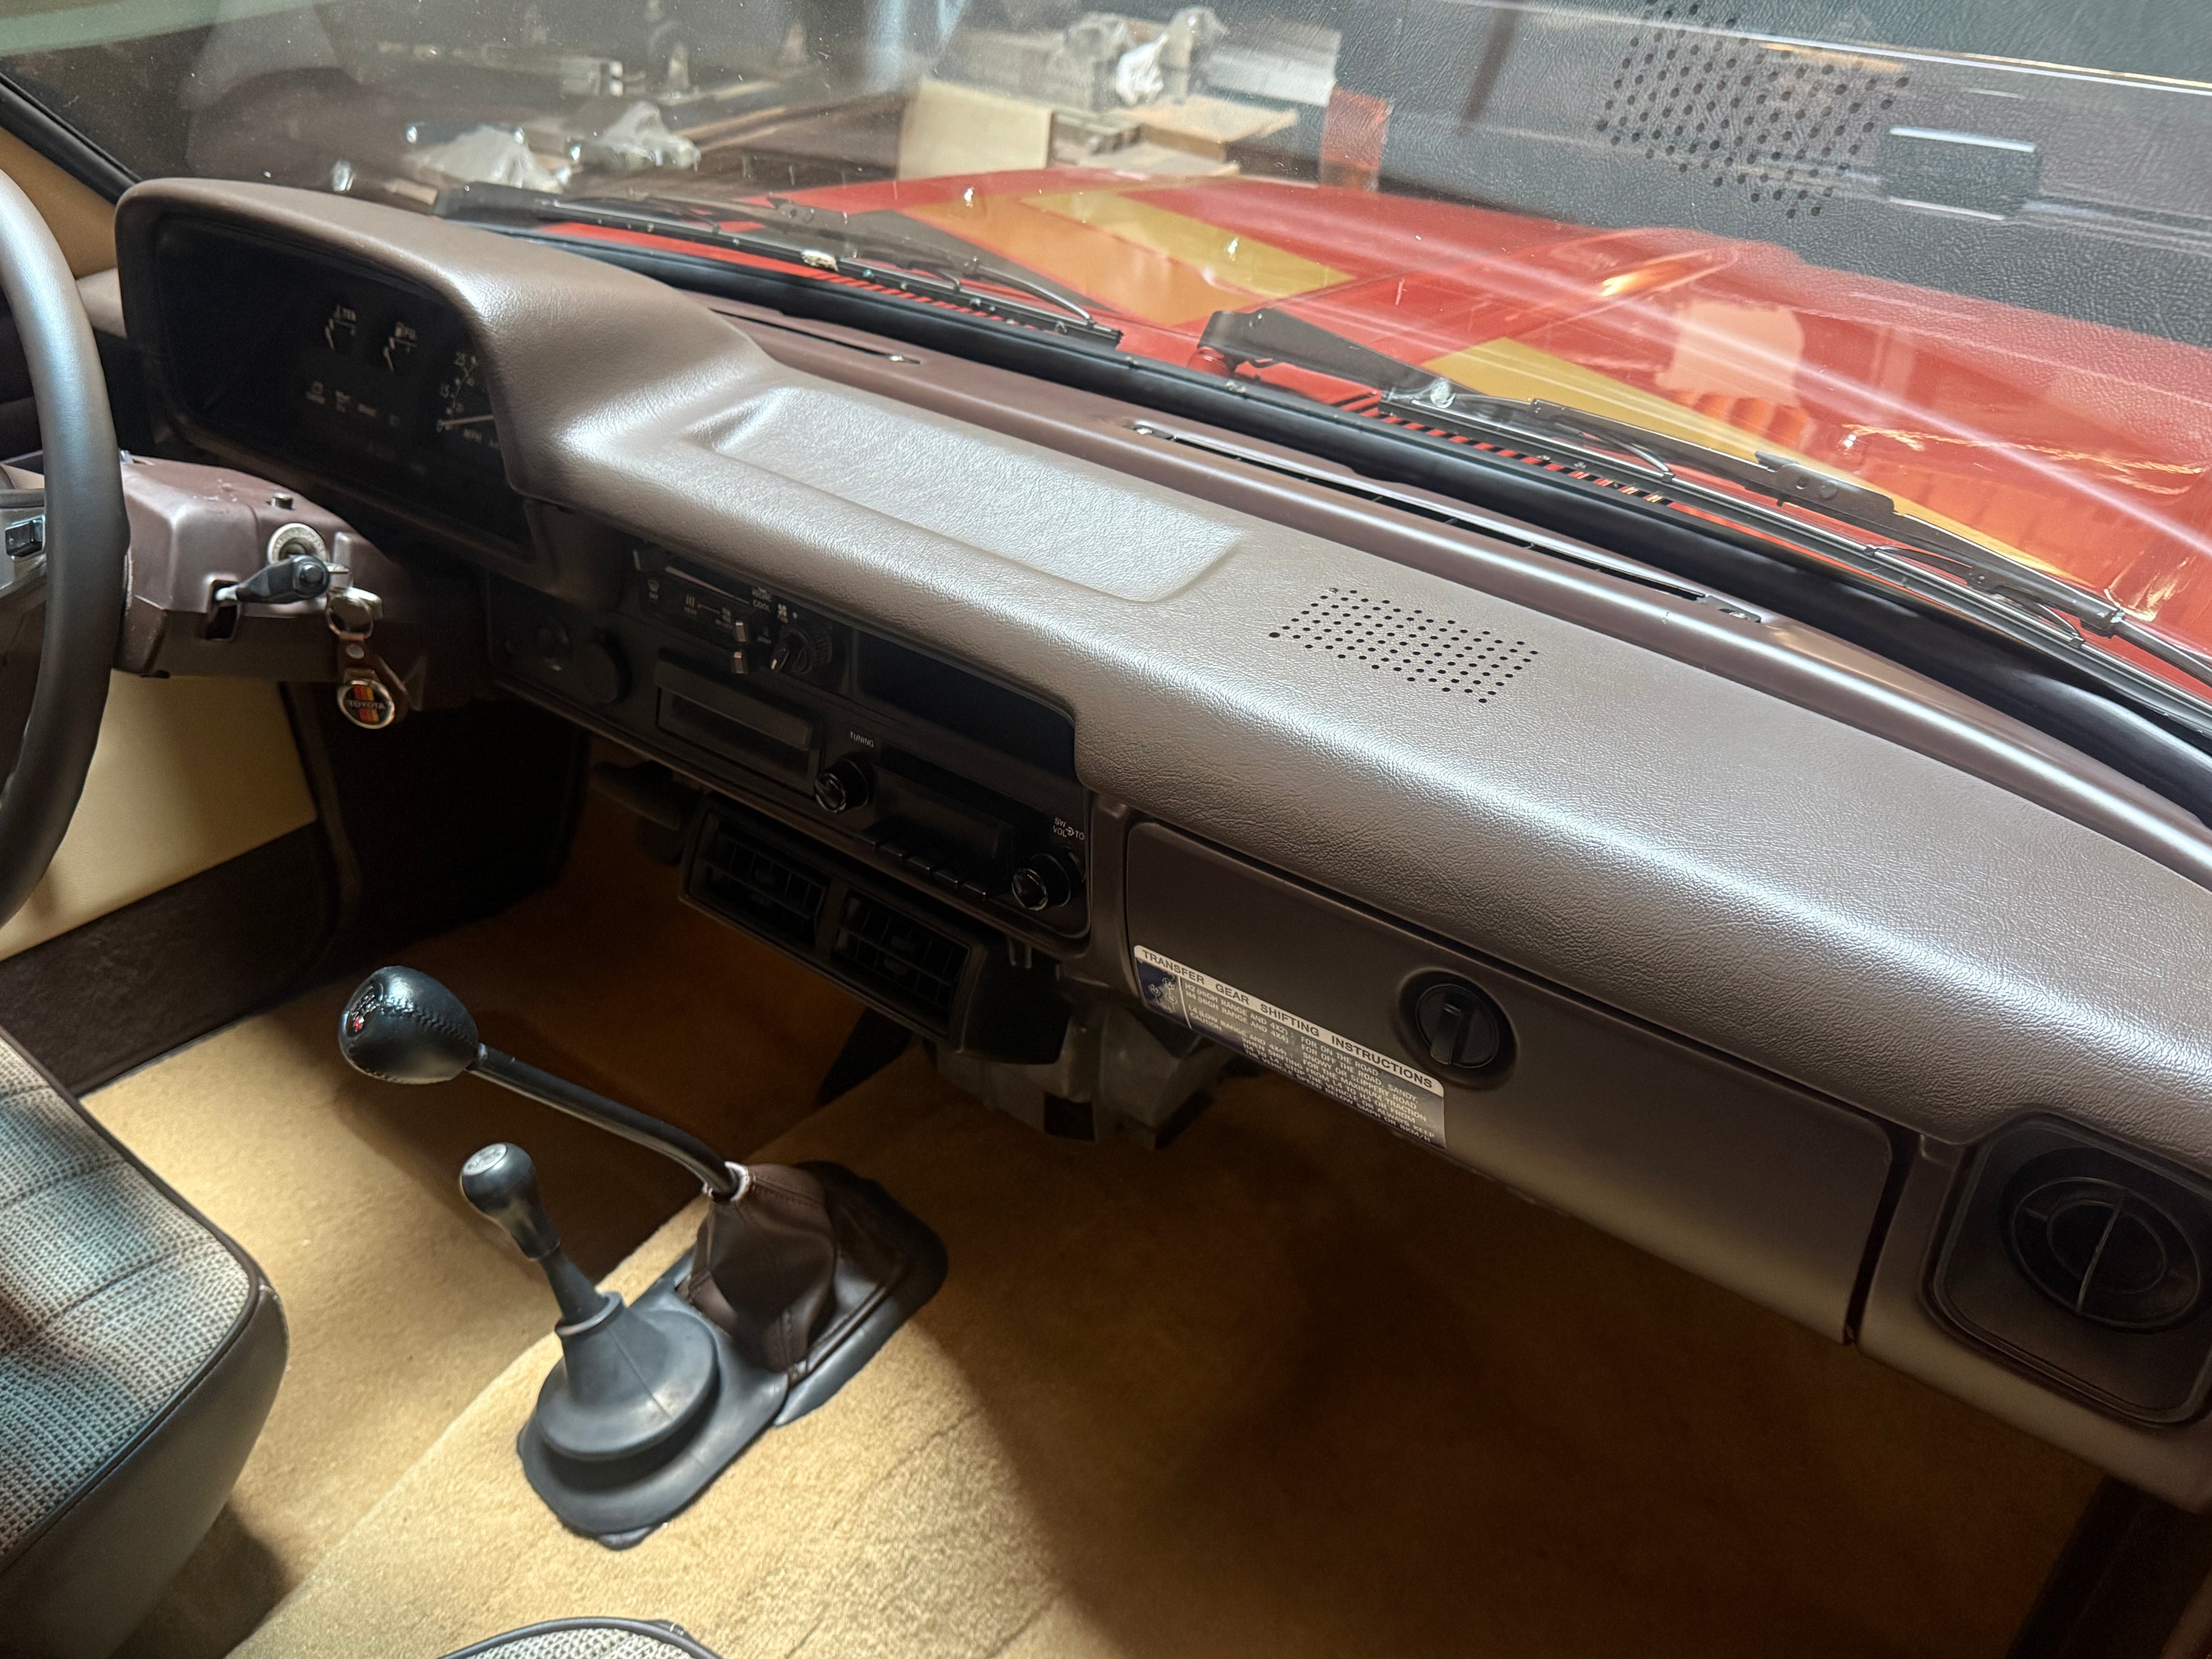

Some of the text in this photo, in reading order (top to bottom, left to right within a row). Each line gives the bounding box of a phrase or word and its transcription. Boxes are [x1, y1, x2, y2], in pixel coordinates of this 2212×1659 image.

[347, 699, 387, 710] TOYOTA
[850, 731, 874, 748] TUNING
[1142, 949, 1432, 1089] TRANSFER GEAR SHIFTING INSTRUCTIONS
[1184, 982, 1195, 993] H2
[1221, 998, 1247, 1017] RANGE
[1249, 1011, 1267, 1026] AND
[1269, 1020, 1288, 1036] 4X2)
[1301, 1035, 1317, 1049] FOR
[1320, 1044, 1332, 1056] ON
[1336, 1051, 1351, 1065] THE
[1354, 1059, 1378, 1077] ROAD
[1221, 1006, 1248, 1024] RANGE
[1250, 1019, 1267, 1033] AND
[1270, 1028, 1288, 1044] 4X4)
[1301, 1043, 1317, 1056] FOR
[1320, 1052, 1336, 1065] OFF
[1339, 1060, 1354, 1074] THE
[1358, 1069, 1384, 1088] ROAD,
[1387, 1082, 1418, 1104] SANDY,
[1190, 1011, 1222, 1032] CAUTION
[1241, 1036, 1264, 1052] WHEN
[1267, 1048, 1302, 1070] SHIFTING
[1305, 1066, 1329, 1083] FROM
[1332, 1079, 1342, 1089] L4
[1346, 1085, 1356, 1096] TO
[1374, 1099, 1387, 1110] OR
[1390, 1106, 1415, 1124] FROM
[1219, 1019, 1247, 1038] RANGE
[1249, 1033, 1266, 1046] AND
[1268, 1042, 1286, 1056] 4X4)
[1302, 1058, 1319, 1071] FOR
[1321, 1067, 1338, 1080] THE
[1340, 1075, 1382, 1101] MAXIMUM
[1385, 1097, 1426, 1122] TRACTION
[1284, 1062, 1305, 1077] STOP
[1308, 1073, 1323, 1085] THE
[1325, 1081, 1358, 1102] VEHICLE
[1361, 1099, 1374, 1110] OR
[1377, 1106, 1409, 1127] ALWAYS
[1302, 1051, 1416, 1110] SNOWY OR SLIPPERY ROAD
